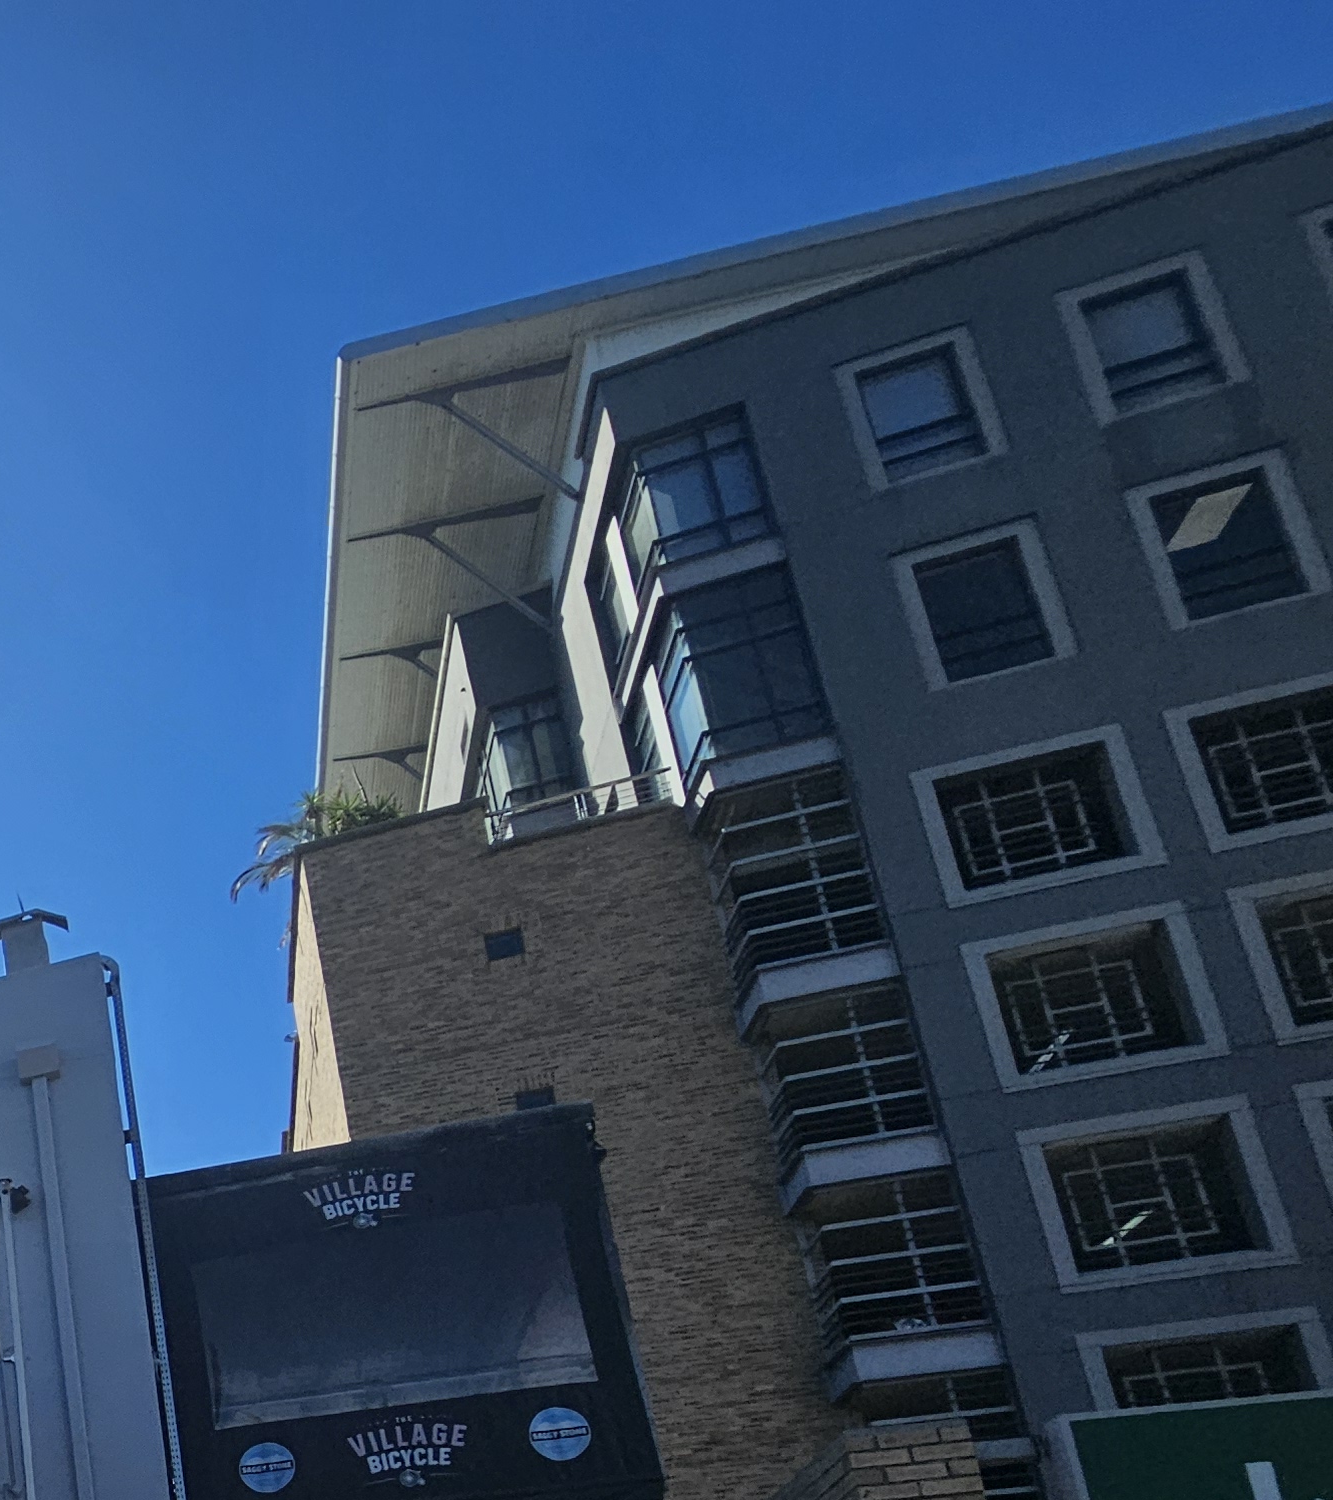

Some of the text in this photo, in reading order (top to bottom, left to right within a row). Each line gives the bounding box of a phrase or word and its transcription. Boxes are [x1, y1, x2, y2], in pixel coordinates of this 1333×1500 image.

[303, 1172, 415, 1207] VILLAGE
[322, 1192, 400, 1220] BICYCLE
[347, 1423, 467, 1457] VILLAGE
[367, 1447, 451, 1474] BICYCLE
